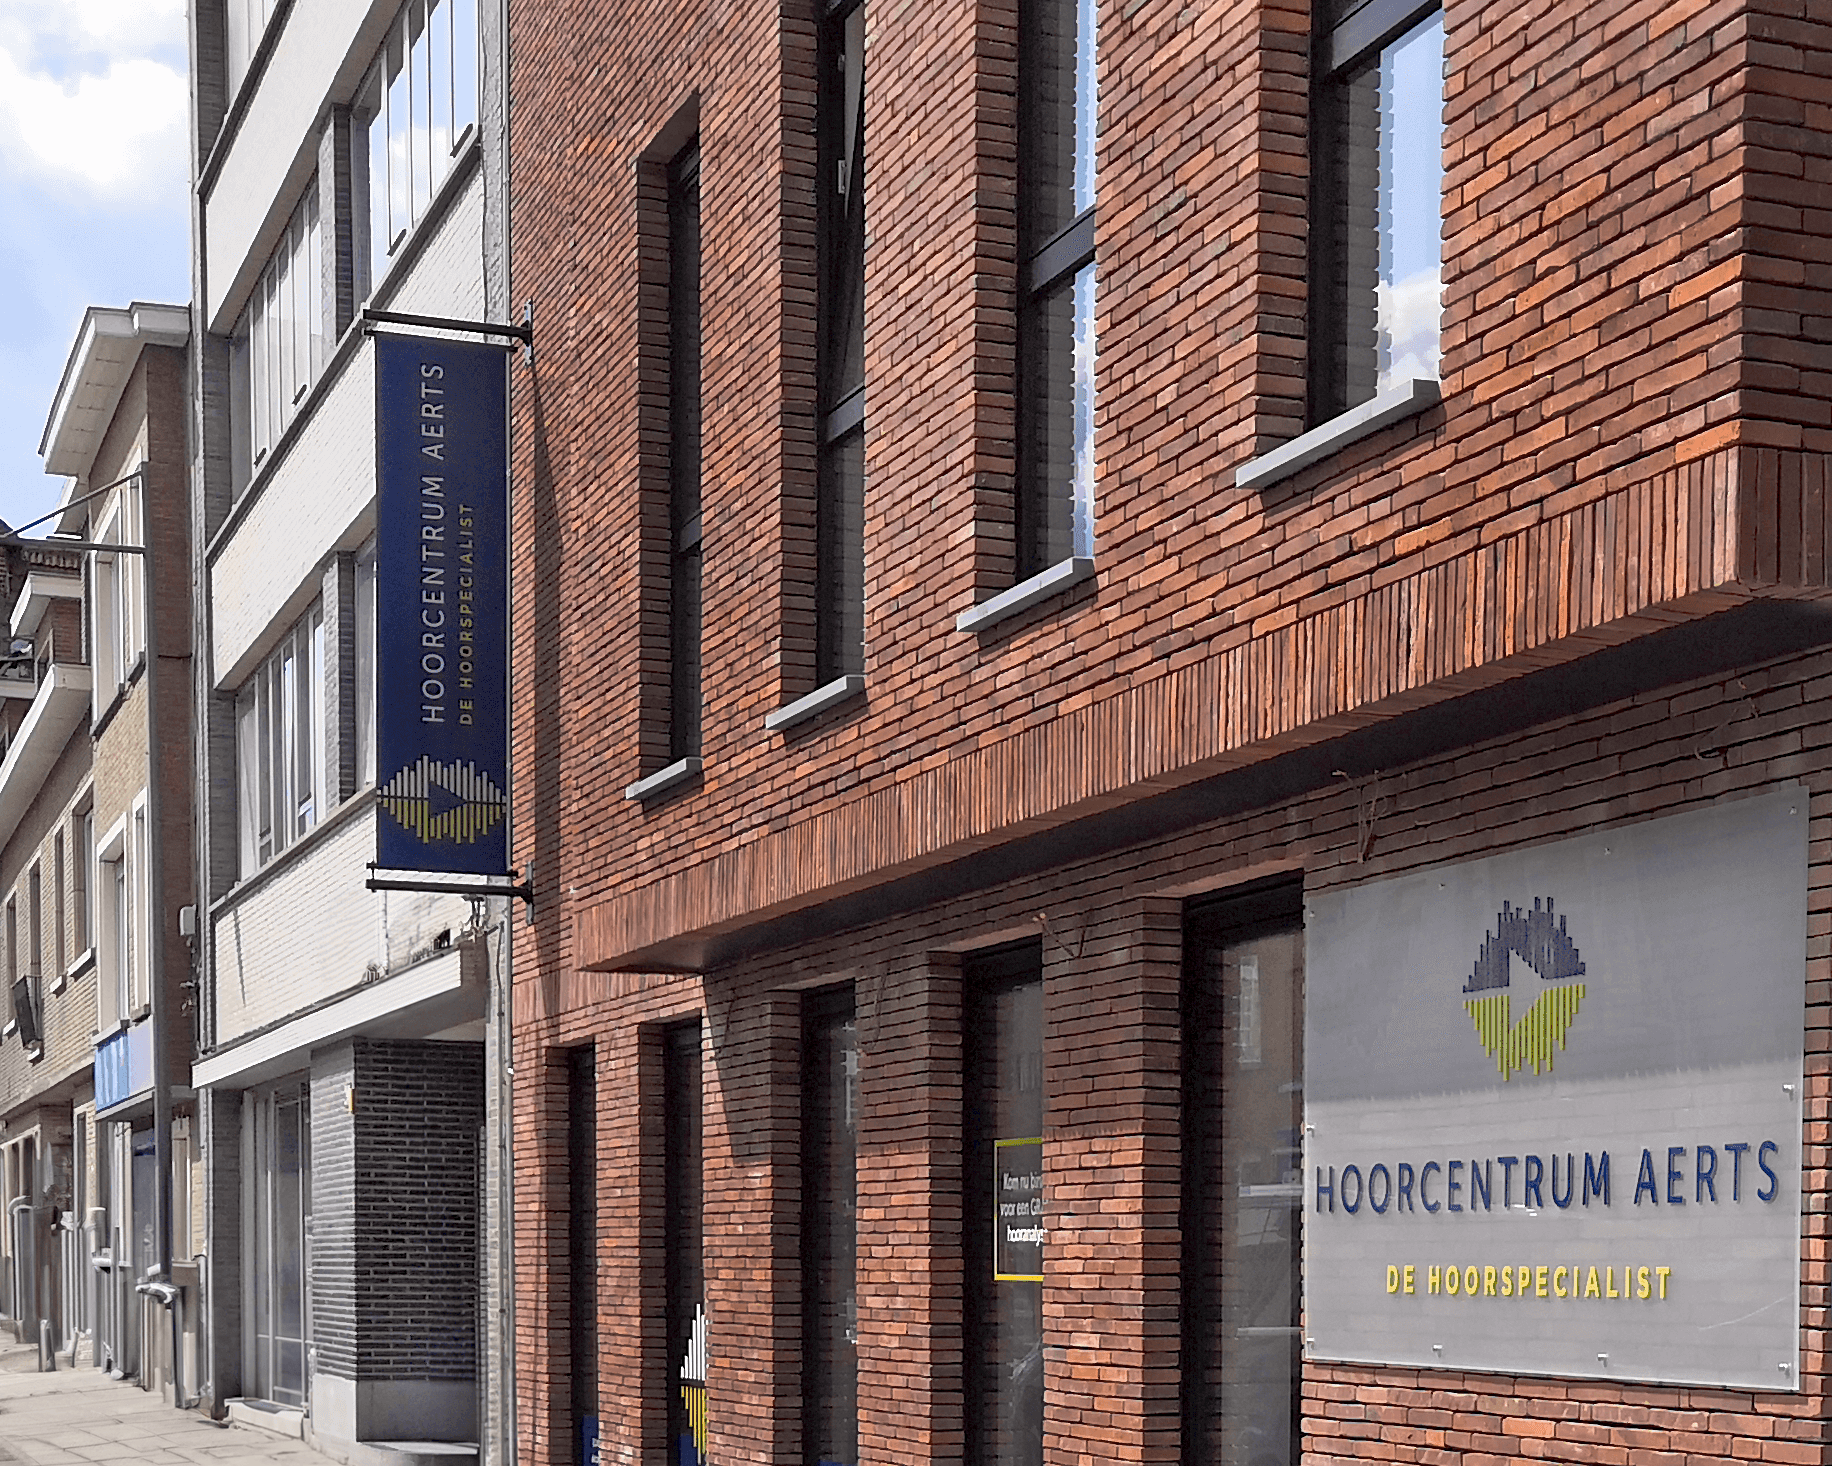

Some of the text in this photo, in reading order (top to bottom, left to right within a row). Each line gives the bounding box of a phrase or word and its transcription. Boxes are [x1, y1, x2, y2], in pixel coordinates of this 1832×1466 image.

[421, 363, 446, 724] HOORCENTRUM AERTS
[458, 503, 475, 727] DE HOORSPECIALIST
[1316, 1140, 1781, 1215] HOORCENTRUM AERTS
[1386, 1264, 1672, 1300] DE HOORSPECIALIST
